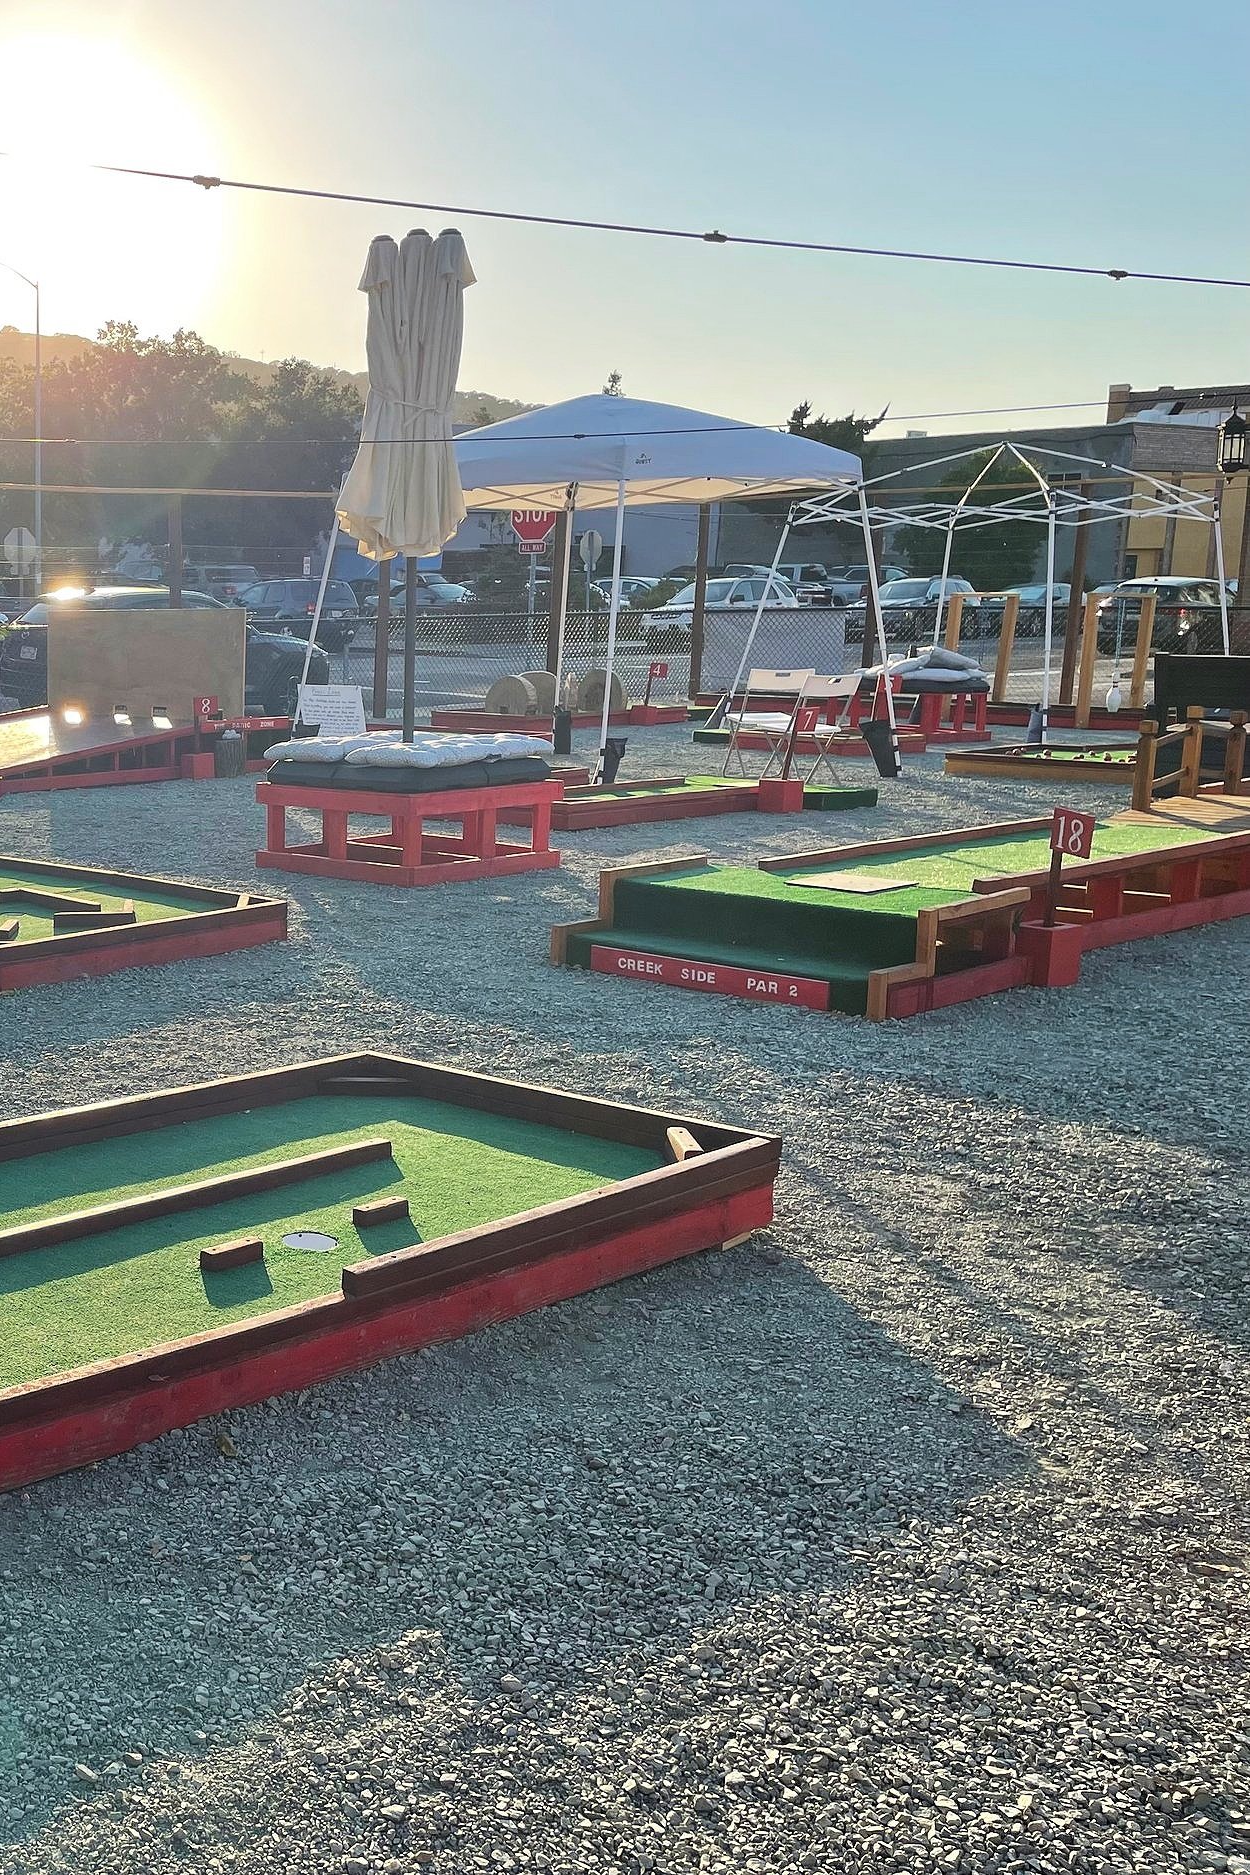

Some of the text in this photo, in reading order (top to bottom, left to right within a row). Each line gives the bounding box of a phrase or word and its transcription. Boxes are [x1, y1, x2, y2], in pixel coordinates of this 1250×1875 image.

[514, 510, 549, 523] STOP
[653, 664, 661, 676] 4
[201, 698, 211, 714] 8
[804, 711, 814, 730] 7
[1055, 816, 1084, 853] 18
[618, 957, 798, 997] CREEK SIDE PAR 2
